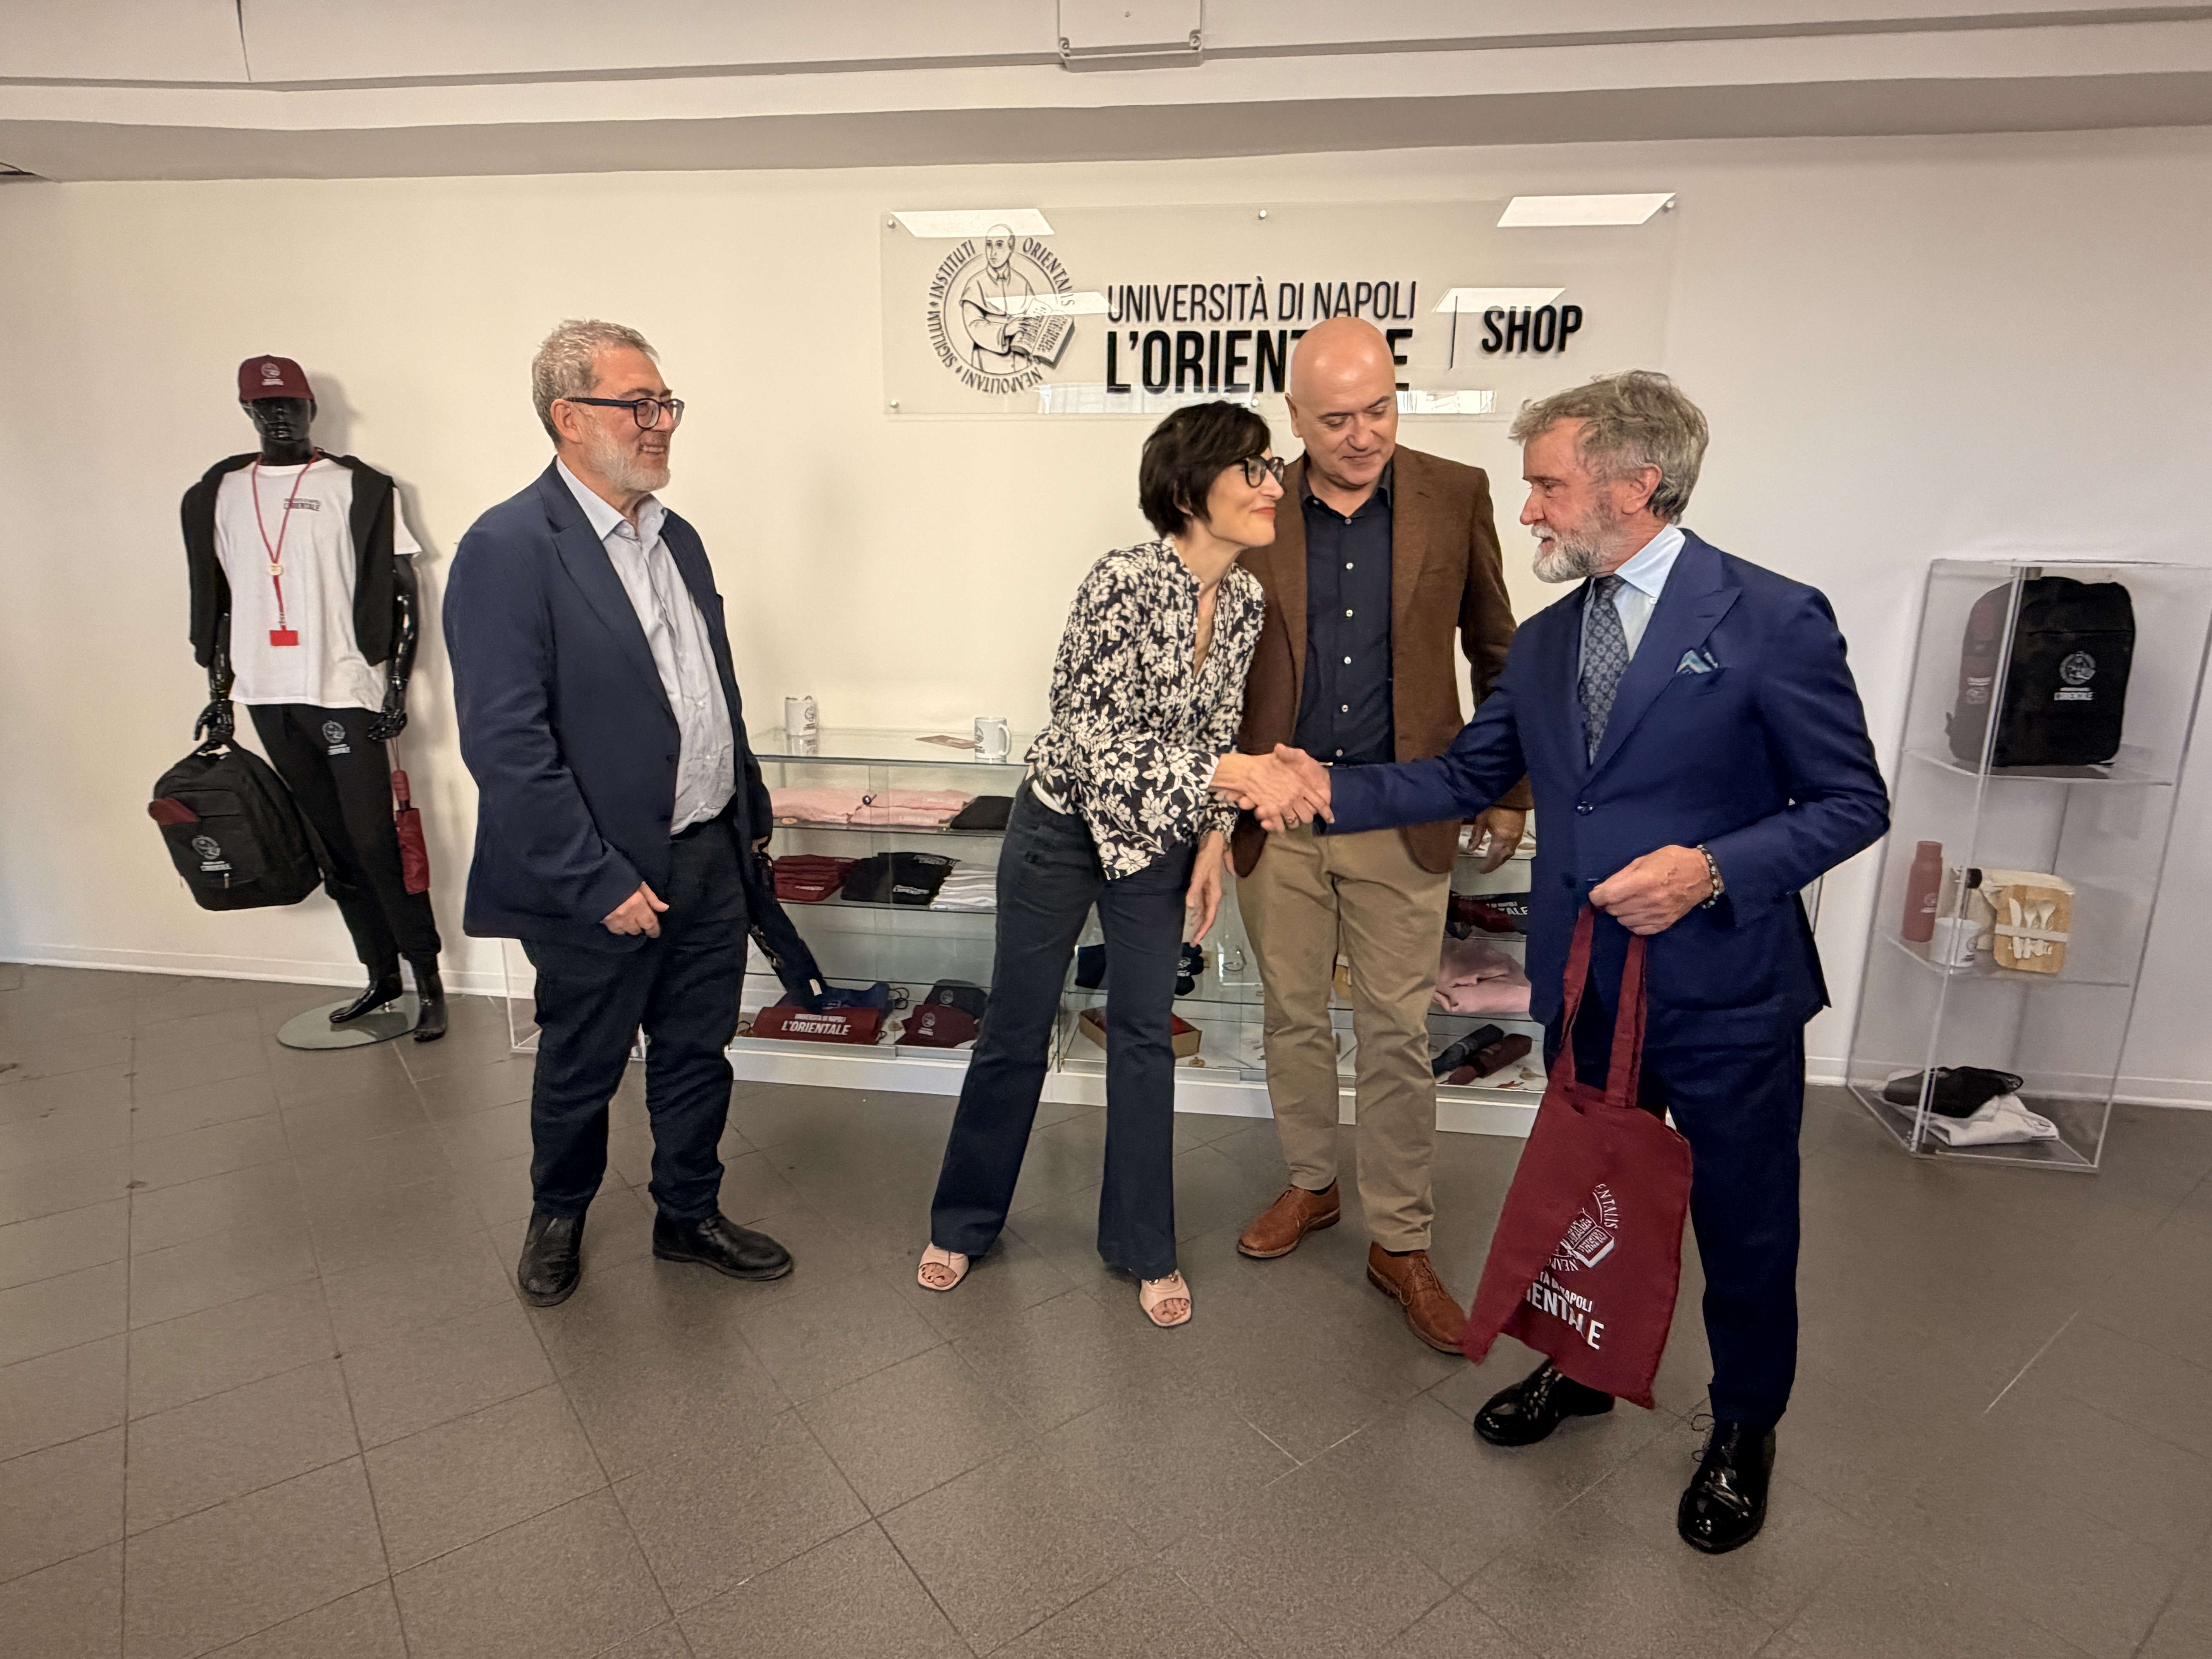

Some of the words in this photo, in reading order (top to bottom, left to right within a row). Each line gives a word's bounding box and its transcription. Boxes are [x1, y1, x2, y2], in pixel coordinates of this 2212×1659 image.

[929, 239, 976, 300] INSTITUTI
[1023, 237, 1075, 306] ORIENTALIS
[1108, 275, 1269, 322] UNIVERSITÀ
[1278, 282, 1304, 321] DI
[1312, 281, 1417, 321] NAPOLI
[927, 311, 958, 368] SIGILLUM
[1481, 305, 1583, 353] SHOP
[960, 367, 1043, 394] NEAPOLITANI
[1106, 328, 1413, 395] L'ORIENE
[781, 1020, 852, 1036] L'ORIENTALE
